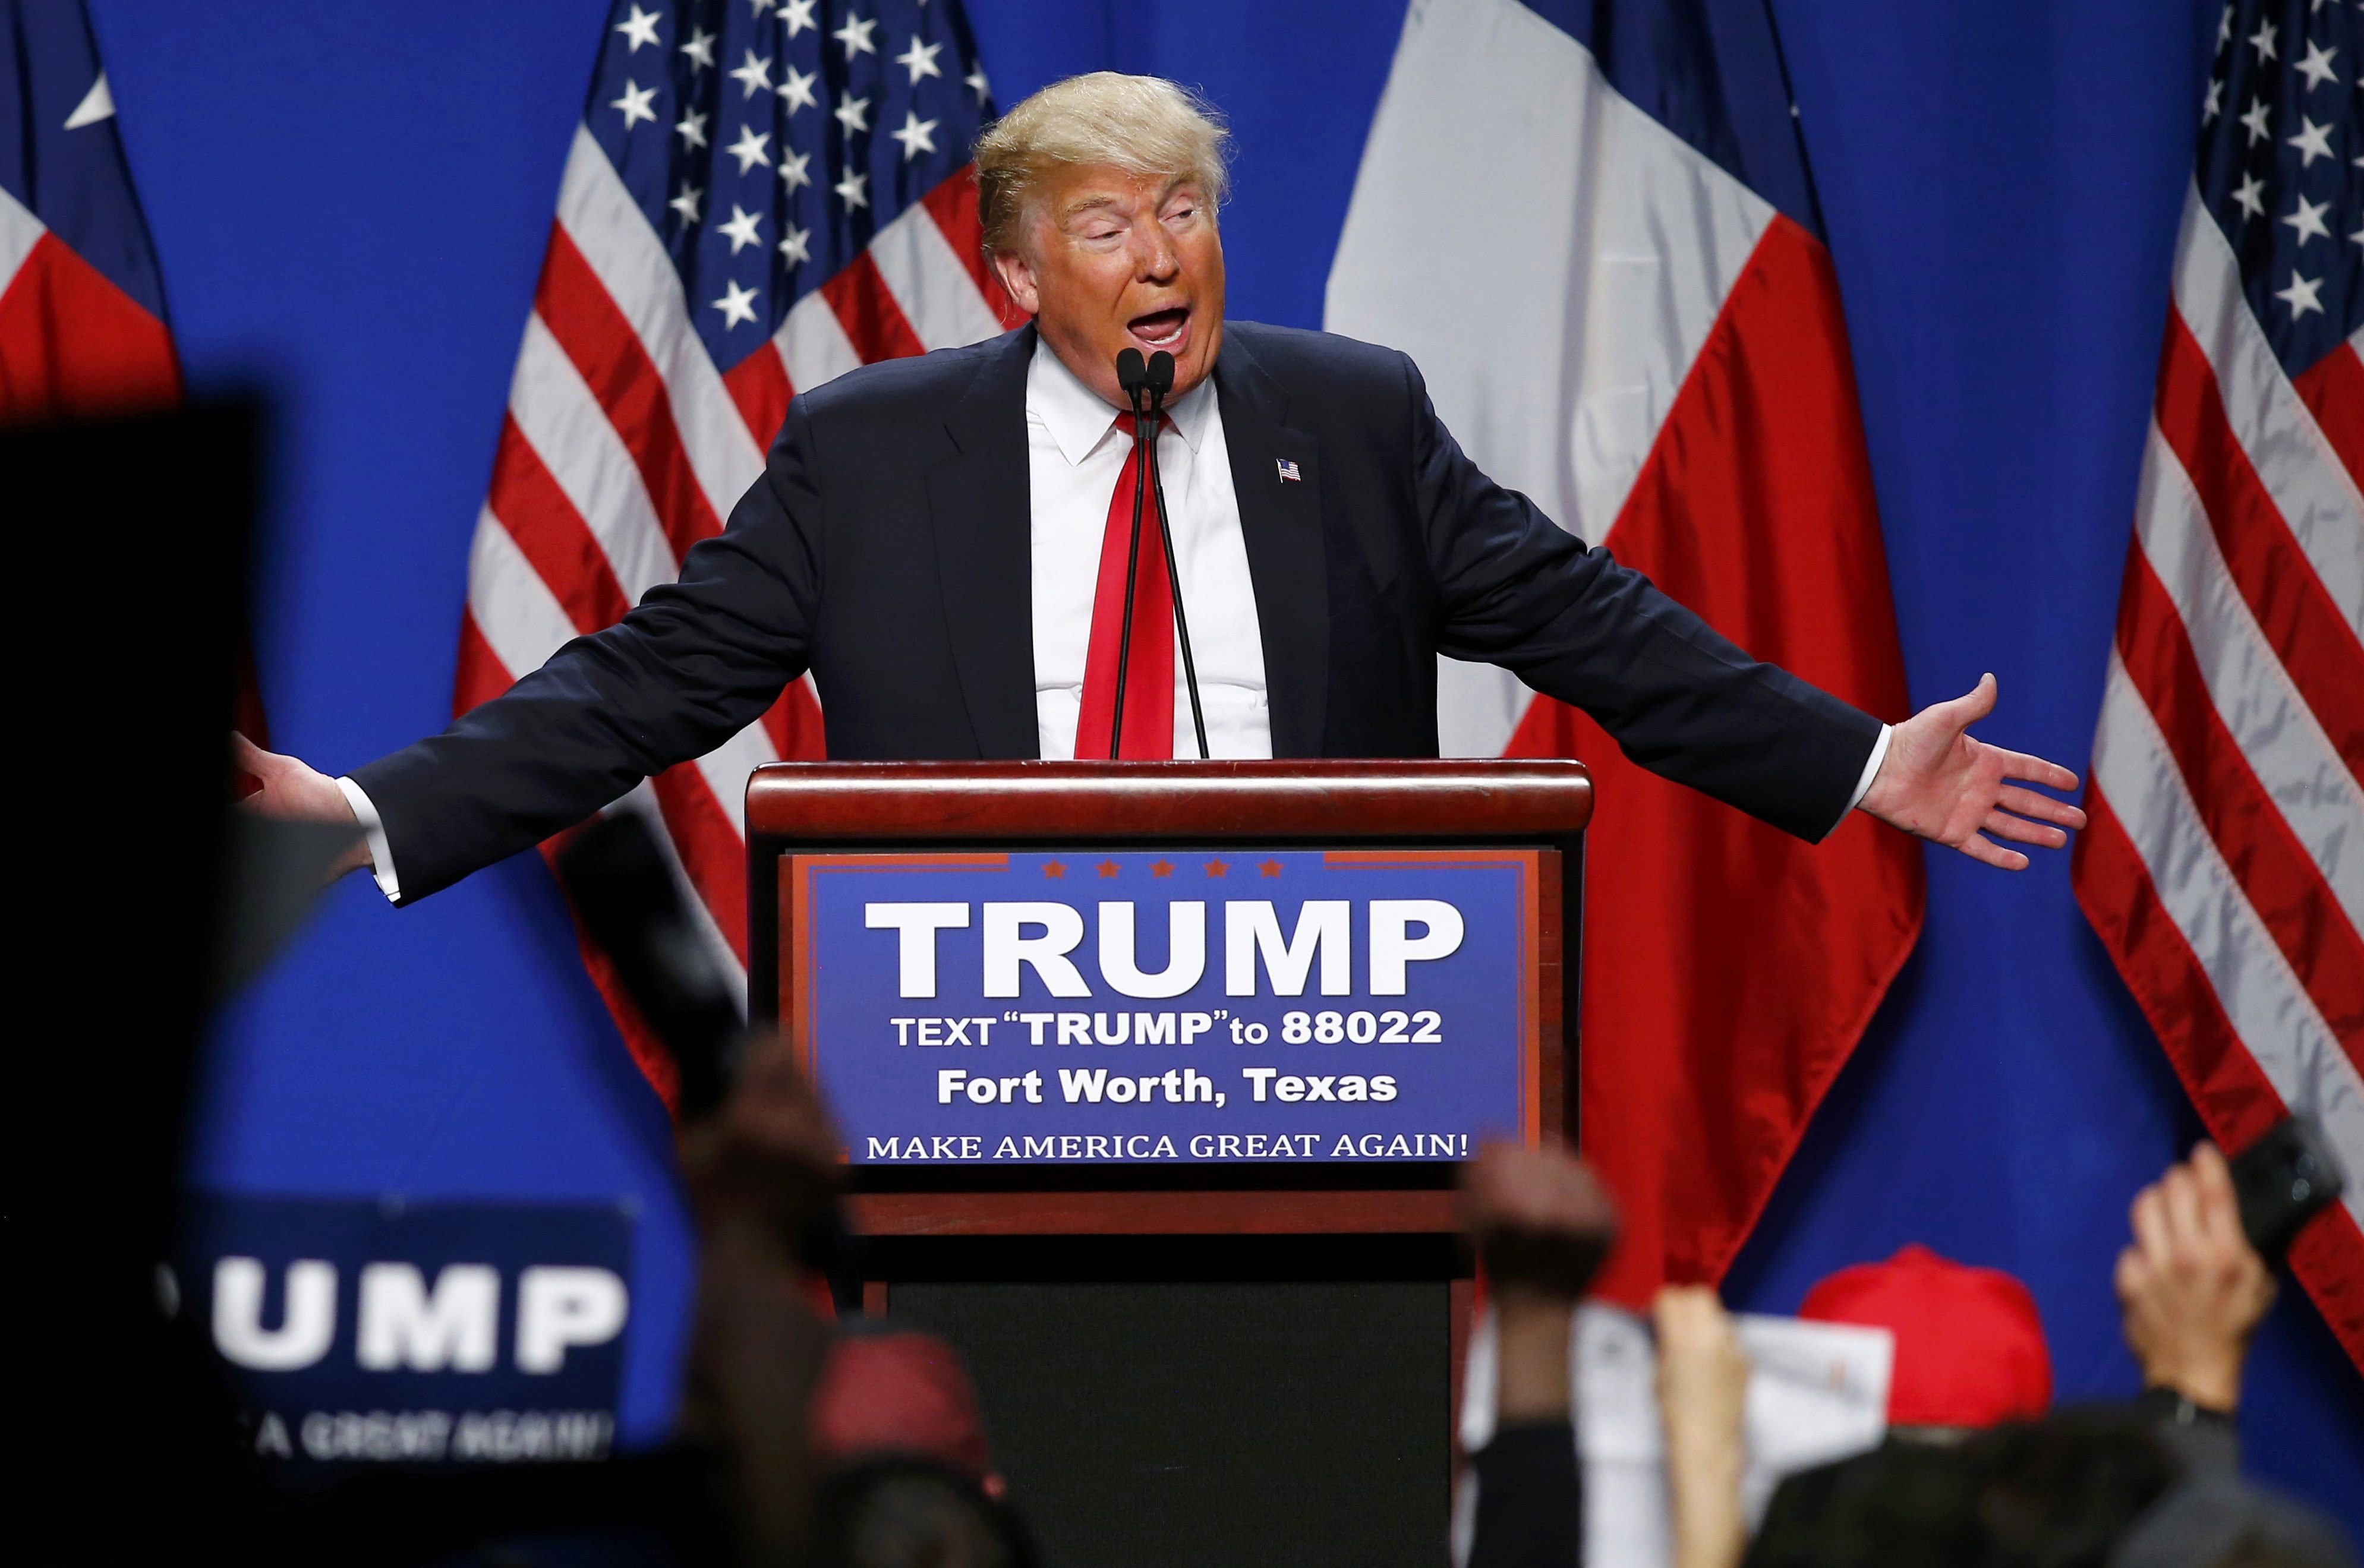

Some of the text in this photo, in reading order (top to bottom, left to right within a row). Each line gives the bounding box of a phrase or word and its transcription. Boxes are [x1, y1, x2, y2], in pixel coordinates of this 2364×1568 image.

[865, 900, 1465, 999] TRUMP
[890, 1016, 997, 1047] TEXT
[1229, 1016, 1268, 1045] to
[1281, 1010, 1443, 1046] 88022
[938, 1067, 1398, 1109] Fort Worth, Texas
[866, 1133, 1469, 1160] MAKE AMERICA GREAT AGAIN!
